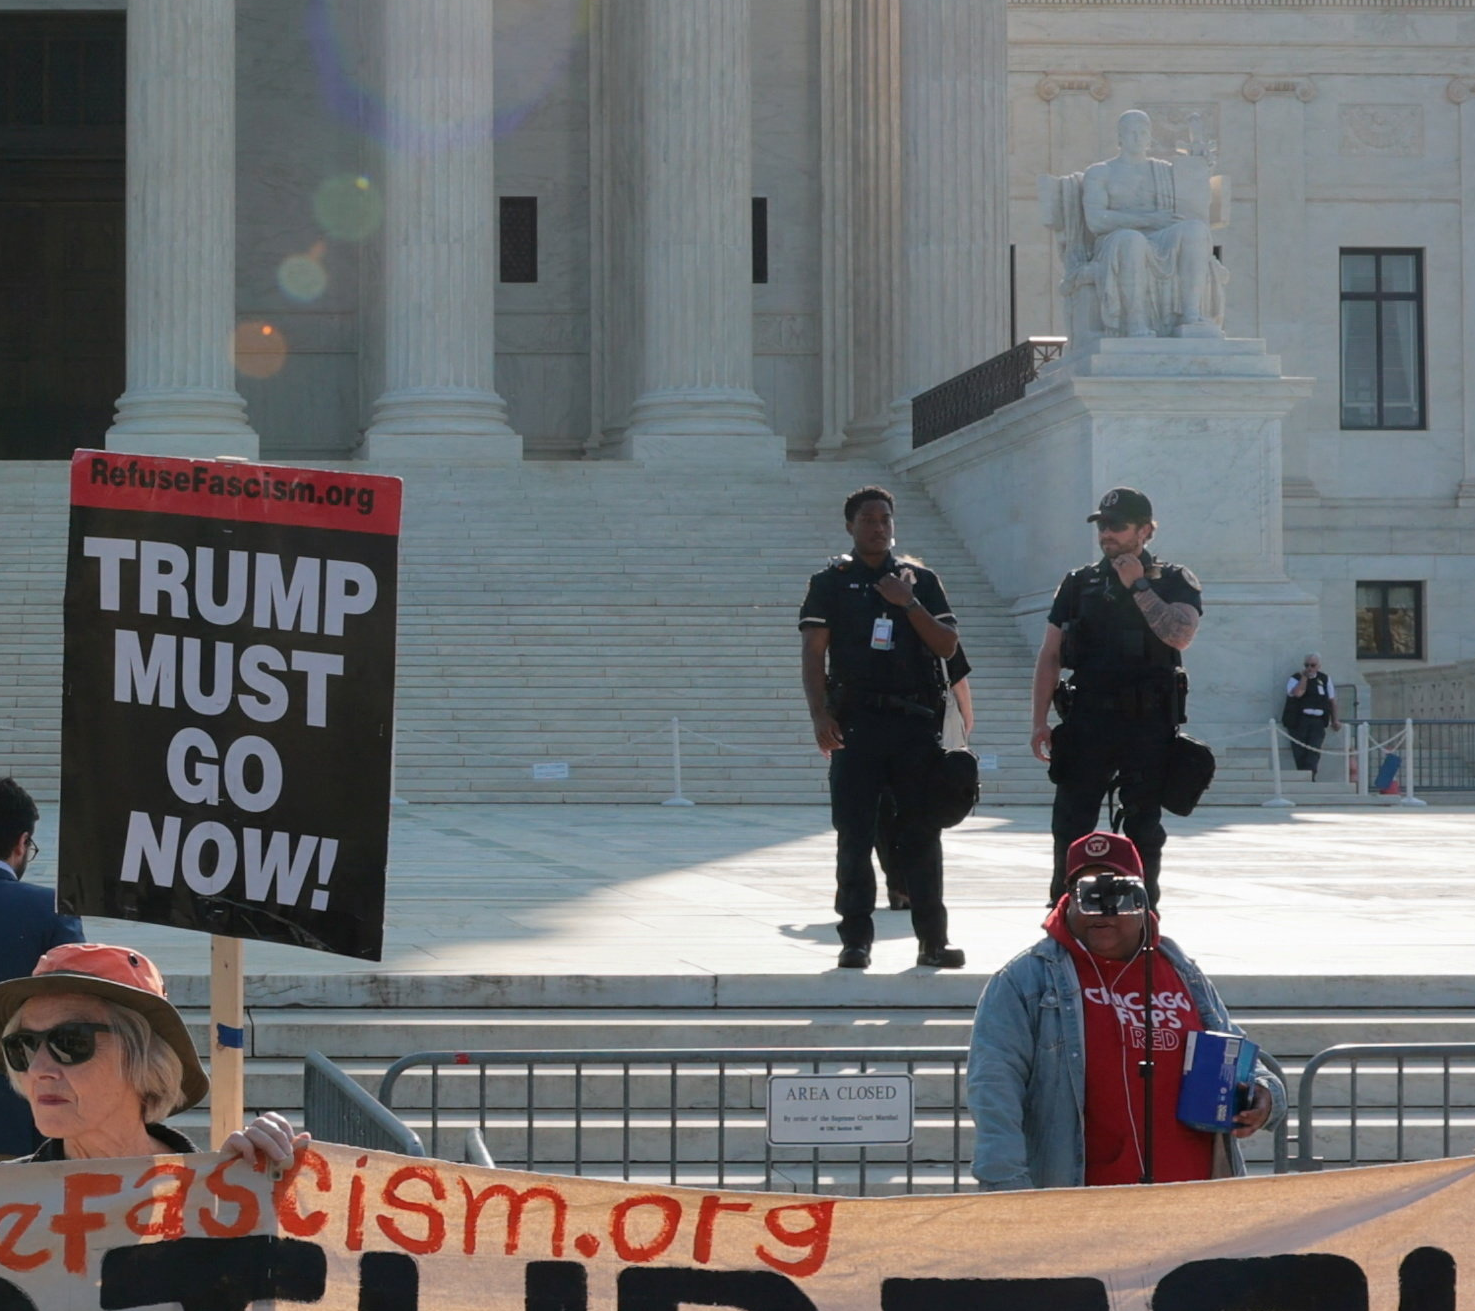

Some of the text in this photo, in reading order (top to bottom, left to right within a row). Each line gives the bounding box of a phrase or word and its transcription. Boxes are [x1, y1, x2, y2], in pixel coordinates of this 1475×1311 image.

[90, 458, 375, 515] RefuseFascism.org
[83, 535, 378, 637] TRUMP
[113, 629, 345, 728] MUST
[166, 727, 284, 813] GO
[120, 810, 339, 912] NOW!
[786, 1085, 897, 1101] AREA CLOSED
